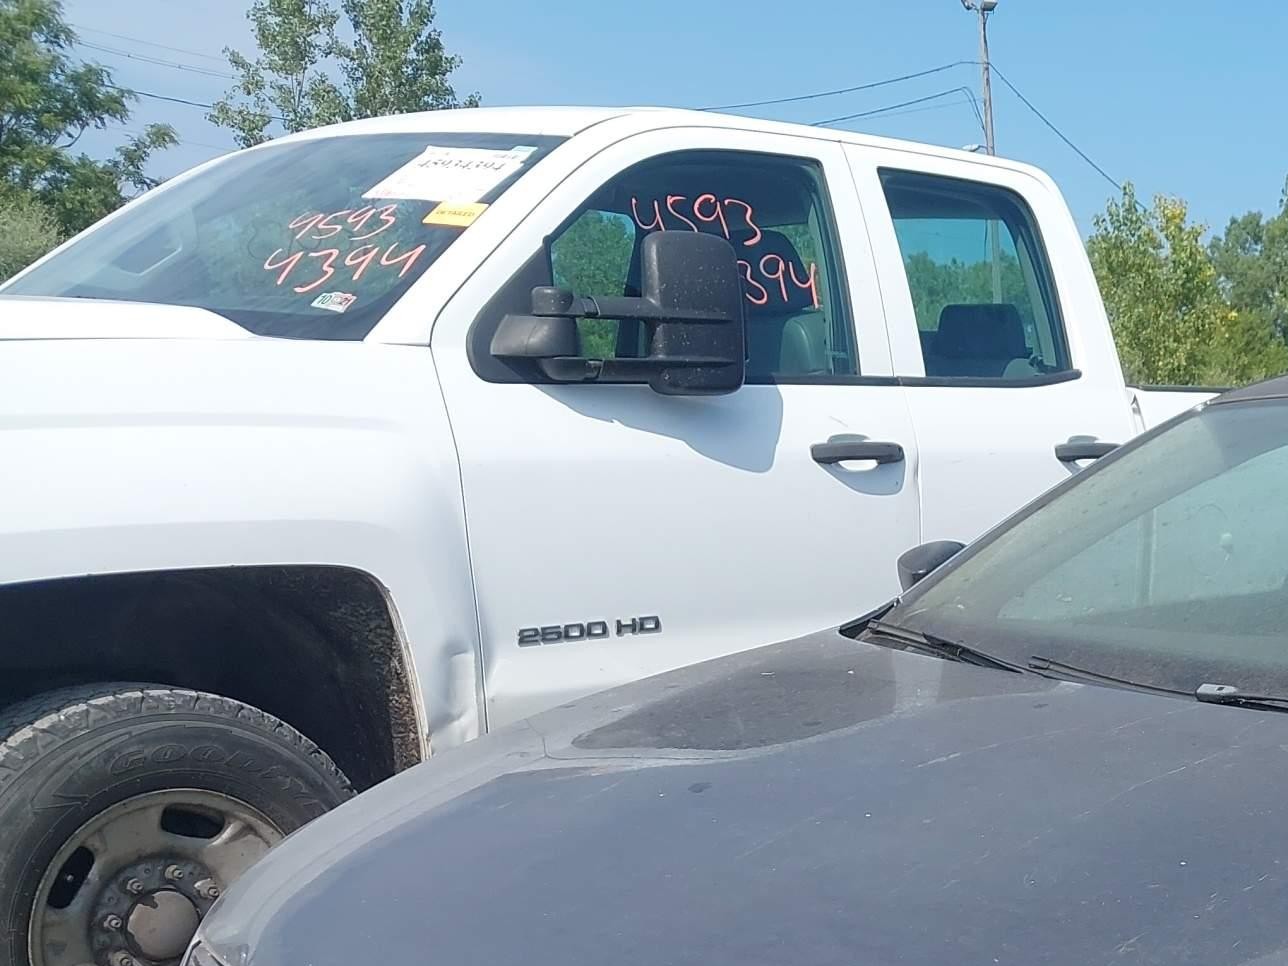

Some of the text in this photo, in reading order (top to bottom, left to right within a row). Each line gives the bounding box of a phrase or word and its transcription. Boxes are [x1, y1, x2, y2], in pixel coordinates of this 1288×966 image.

[632, 193, 762, 246] 4593
[263, 242, 427, 293] 4394
[737, 254, 820, 309] 394
[318, 294, 333, 305] 10
[517, 606, 663, 648] 2500 HD
